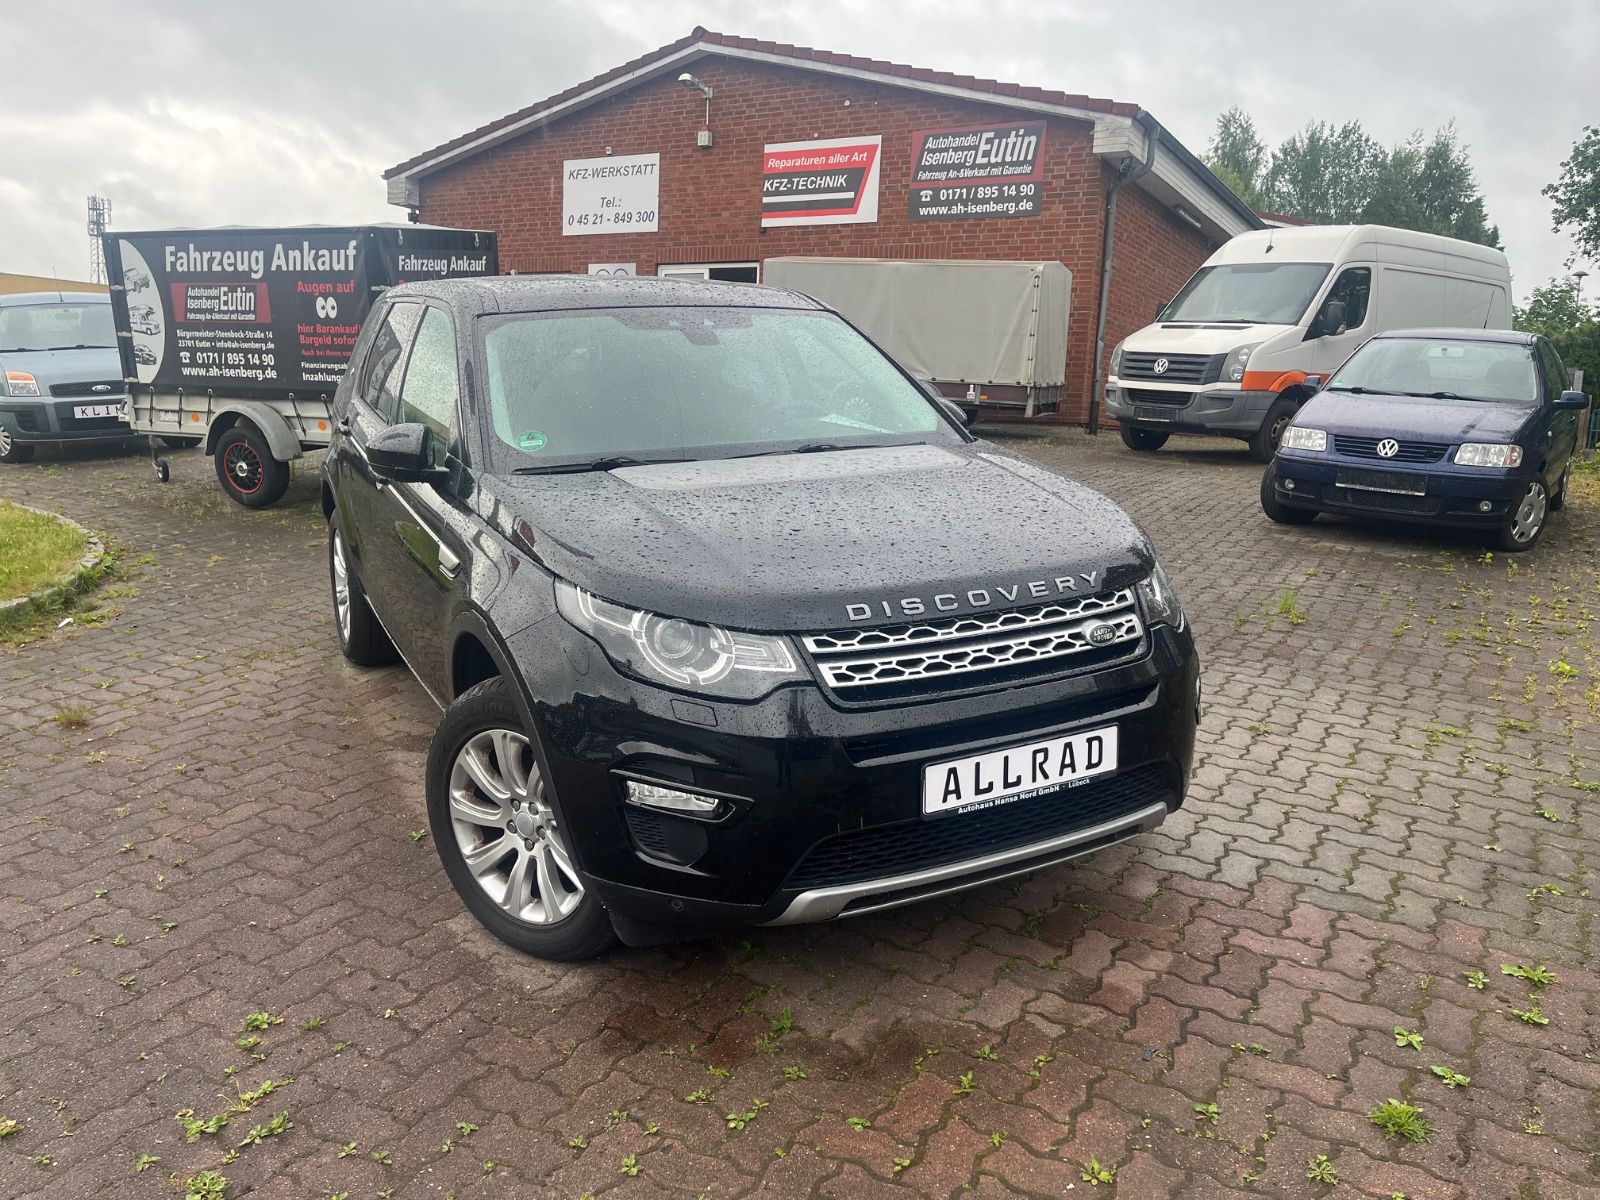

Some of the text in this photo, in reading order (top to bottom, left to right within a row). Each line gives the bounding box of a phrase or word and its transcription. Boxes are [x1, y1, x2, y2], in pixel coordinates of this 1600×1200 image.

[925, 133, 980, 149] Autohandel
[976, 129, 1037, 164] Eutin
[767, 152, 868, 169] Reparaturen aller Art
[921, 149, 976, 166] Isenberg
[568, 163, 656, 180] KFZ-WERKSTATT
[917, 170, 948, 181] Fahrzeug
[990, 166, 1003, 176] mit
[1003, 164, 1032, 175] Garantie
[763, 175, 848, 191] KFZ-TECHNIK
[940, 188, 967, 201] 0171
[977, 186, 999, 198] 895
[1002, 185, 1017, 197] 14
[1020, 184, 1035, 196] 90
[600, 196, 622, 208] Tel.:
[919, 199, 1033, 215] www.ah-isenberg.de
[568, 215, 575, 226] 0
[576, 213, 589, 225] 45
[592, 213, 604, 225] 21
[614, 212, 633, 224] 849
[636, 210, 655, 223] 300
[165, 240, 357, 280] Fahrzeug Ankauf
[398, 254, 487, 275] Fahrzeug Ankauf
[187, 287, 220, 297] Autohandel
[297, 280, 356, 296] Augen auf
[187, 297, 220, 312] Isenberg
[220, 286, 255, 311] Eutin
[265, 331, 273, 339] 14
[297, 323, 315, 333] hier
[195, 340, 211, 348] Eutin
[300, 334, 332, 347] Bargeld
[196, 352, 219, 364] 0171
[227, 353, 245, 365] 895
[247, 354, 260, 365] 14
[262, 354, 275, 366] 90
[301, 361, 349, 371] Finanzierungsab
[182, 366, 278, 381] www.ah-isenberg.de
[844, 570, 1101, 622] DISCOVERY
[942, 734, 1104, 804] ALLRAD
[957, 779, 1091, 814] Autohaus Hansa Nord GmbH Lübeck
